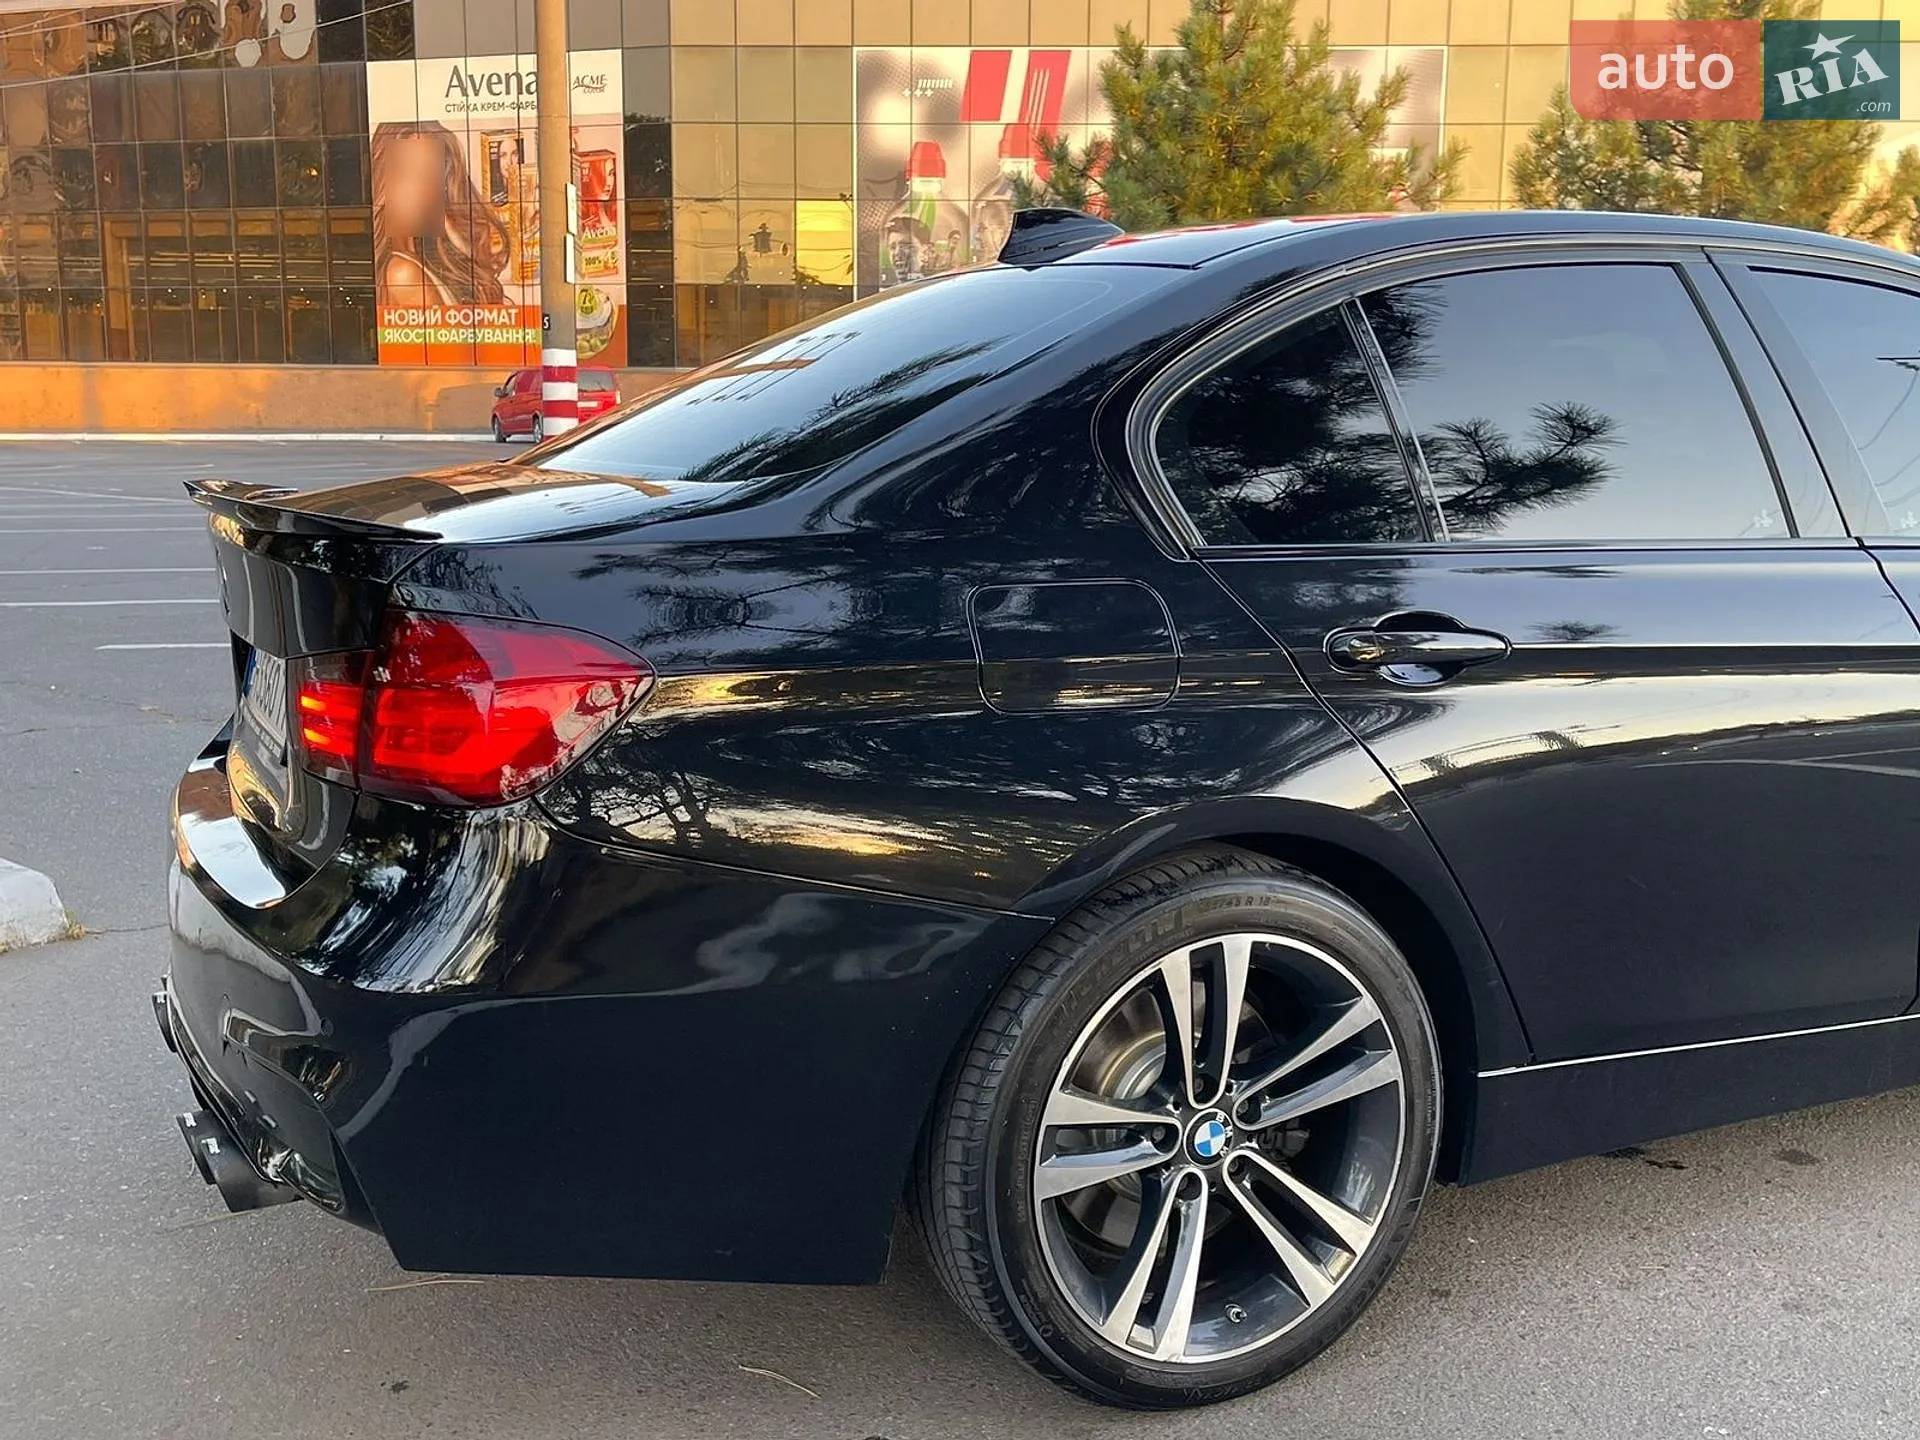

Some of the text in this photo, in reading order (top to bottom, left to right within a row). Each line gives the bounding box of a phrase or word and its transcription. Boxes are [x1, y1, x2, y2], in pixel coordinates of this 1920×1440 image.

[445, 65, 538, 98] Avena
[573, 74, 608, 86] ACME
[445, 100, 538, 113] СТІЙКА КРЕМ-ФАРБ
[384, 305, 519, 326] НОВИЙ ФОРМАТ
[384, 329, 435, 344] ЯКОСТІ
